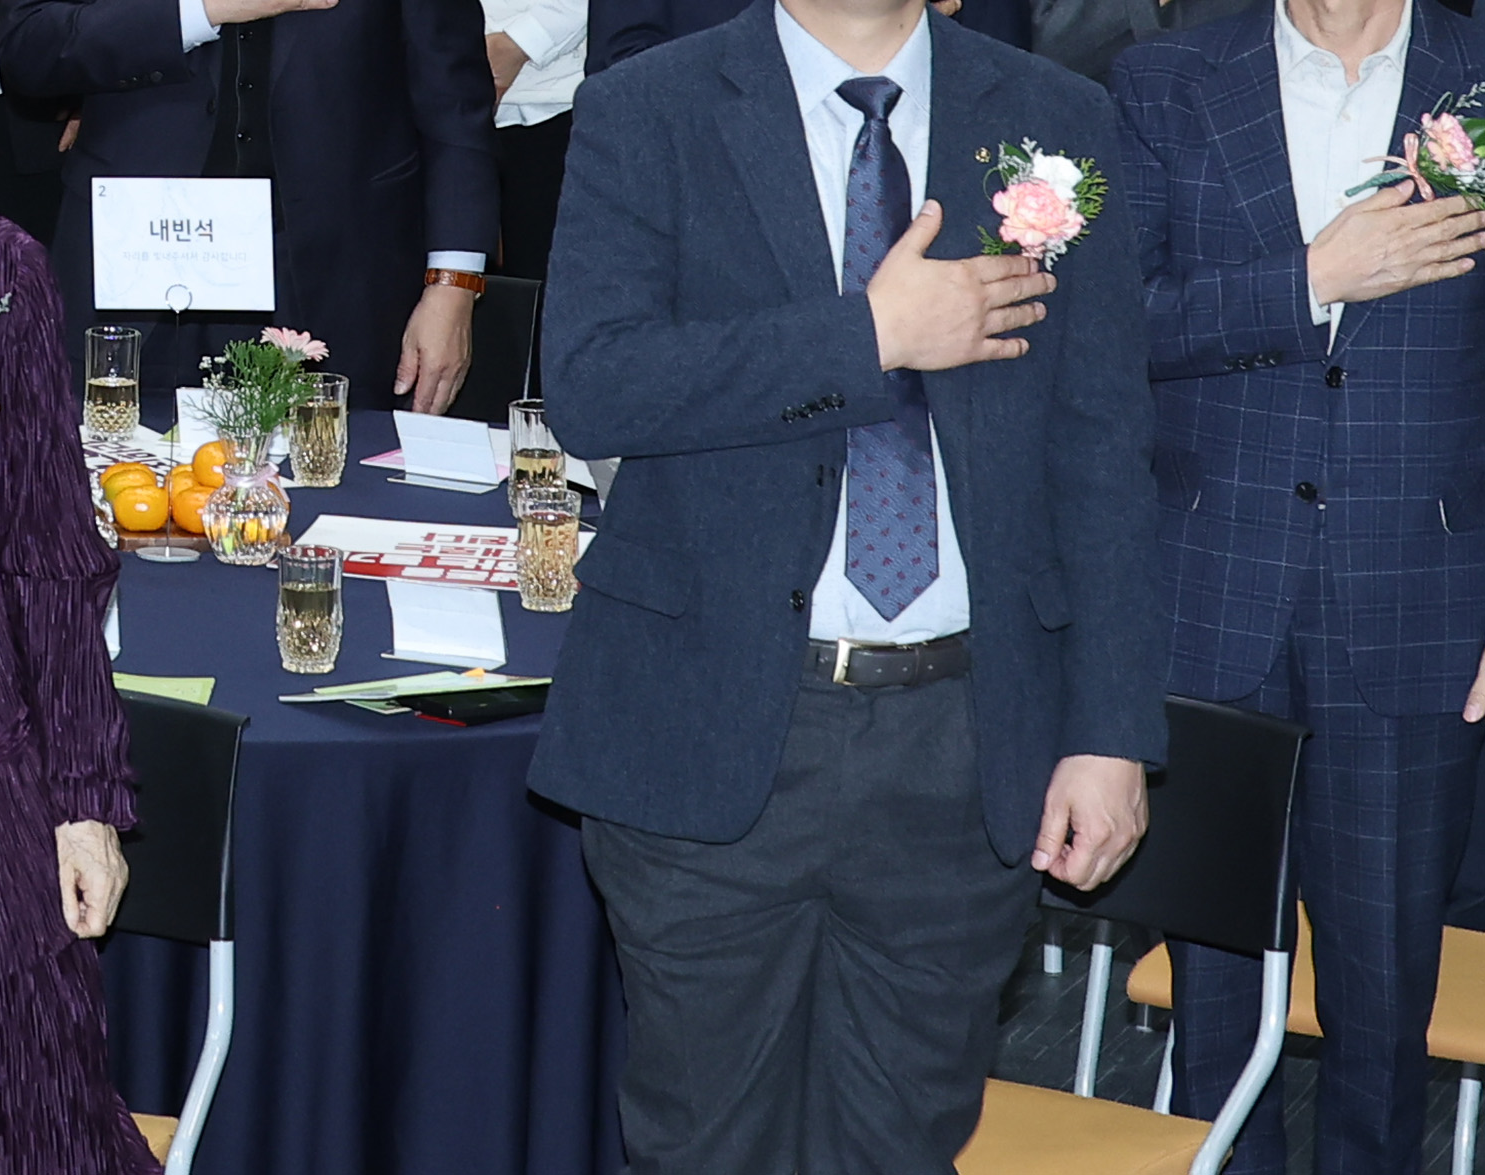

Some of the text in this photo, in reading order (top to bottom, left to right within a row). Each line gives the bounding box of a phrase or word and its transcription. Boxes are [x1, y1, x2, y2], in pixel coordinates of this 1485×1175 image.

[98, 185, 106, 197] 2
[149, 219, 213, 243] 내빈석
[123, 251, 149, 262] 자리를
[202, 252, 247, 262] 감사합니다
[395, 543, 518, 558] 대로는
[436, 556, 518, 571] 하는
